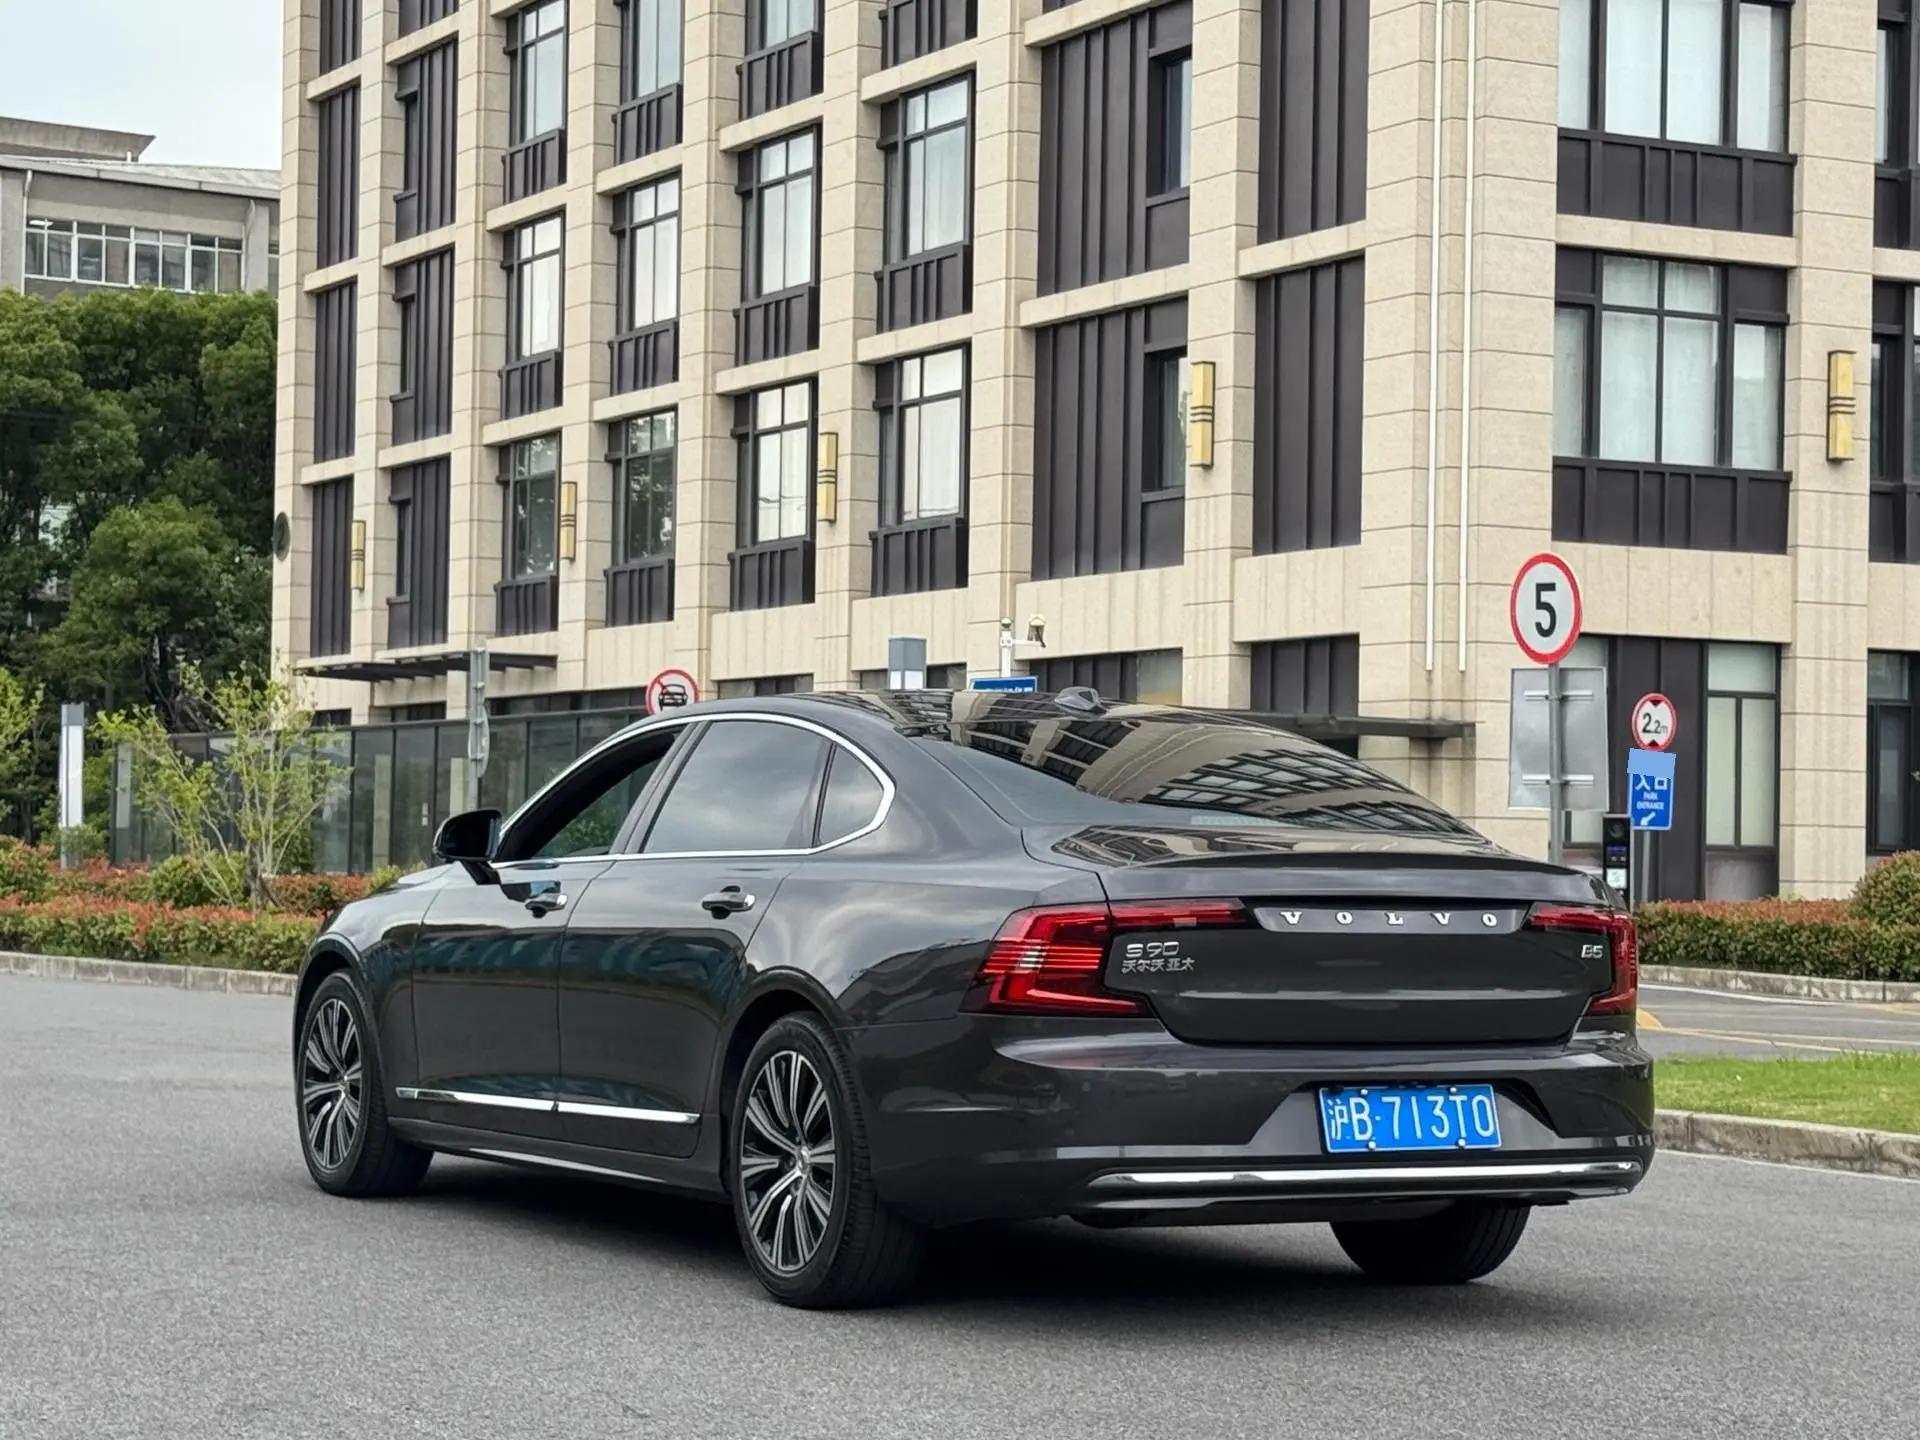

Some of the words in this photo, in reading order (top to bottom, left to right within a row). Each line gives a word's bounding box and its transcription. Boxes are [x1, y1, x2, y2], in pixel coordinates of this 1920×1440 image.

[1535, 582, 1557, 638] 5
[1635, 774, 1668, 790] 入口
[1281, 911, 1498, 927] VOLVO
[1125, 941, 1180, 958] S90
[1581, 944, 1604, 959] B5
[1121, 957, 1195, 974] 沃尔沃亚太
